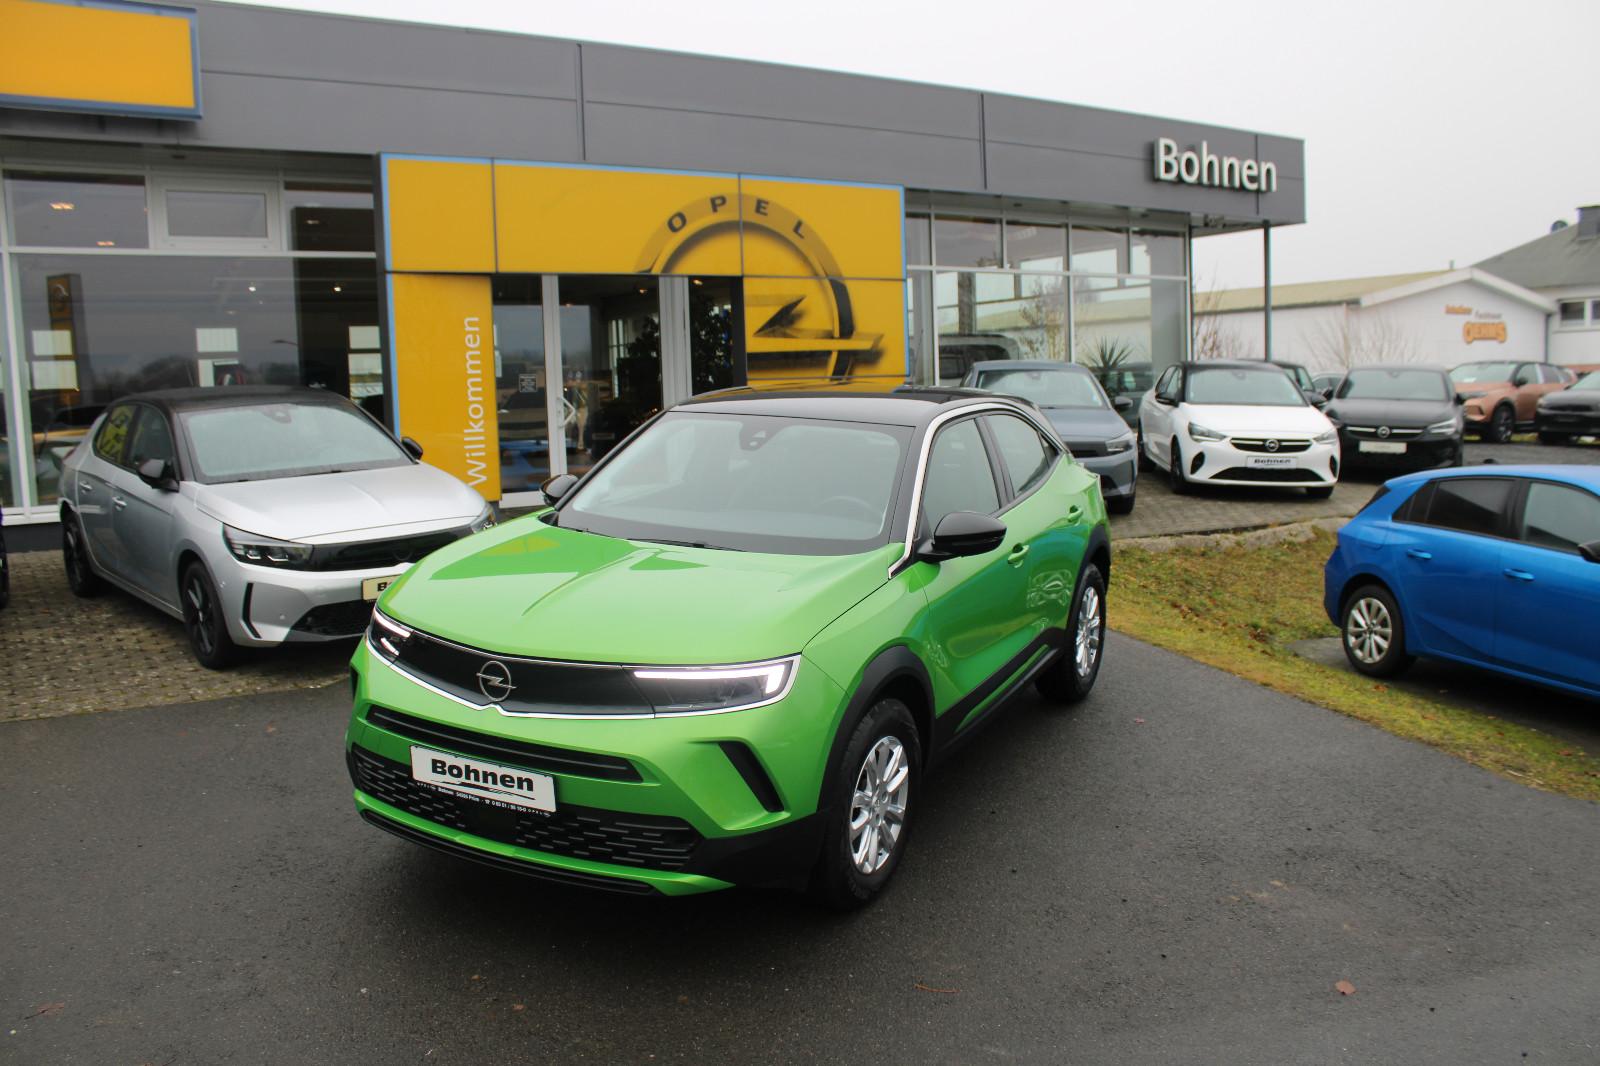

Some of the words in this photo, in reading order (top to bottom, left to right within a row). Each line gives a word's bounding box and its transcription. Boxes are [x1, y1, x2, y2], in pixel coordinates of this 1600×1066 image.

[1156, 136, 1278, 193] Bohnen
[667, 194, 805, 240] OPEL
[463, 316, 488, 486] Willkommen
[431, 758, 534, 792] Bohnen
